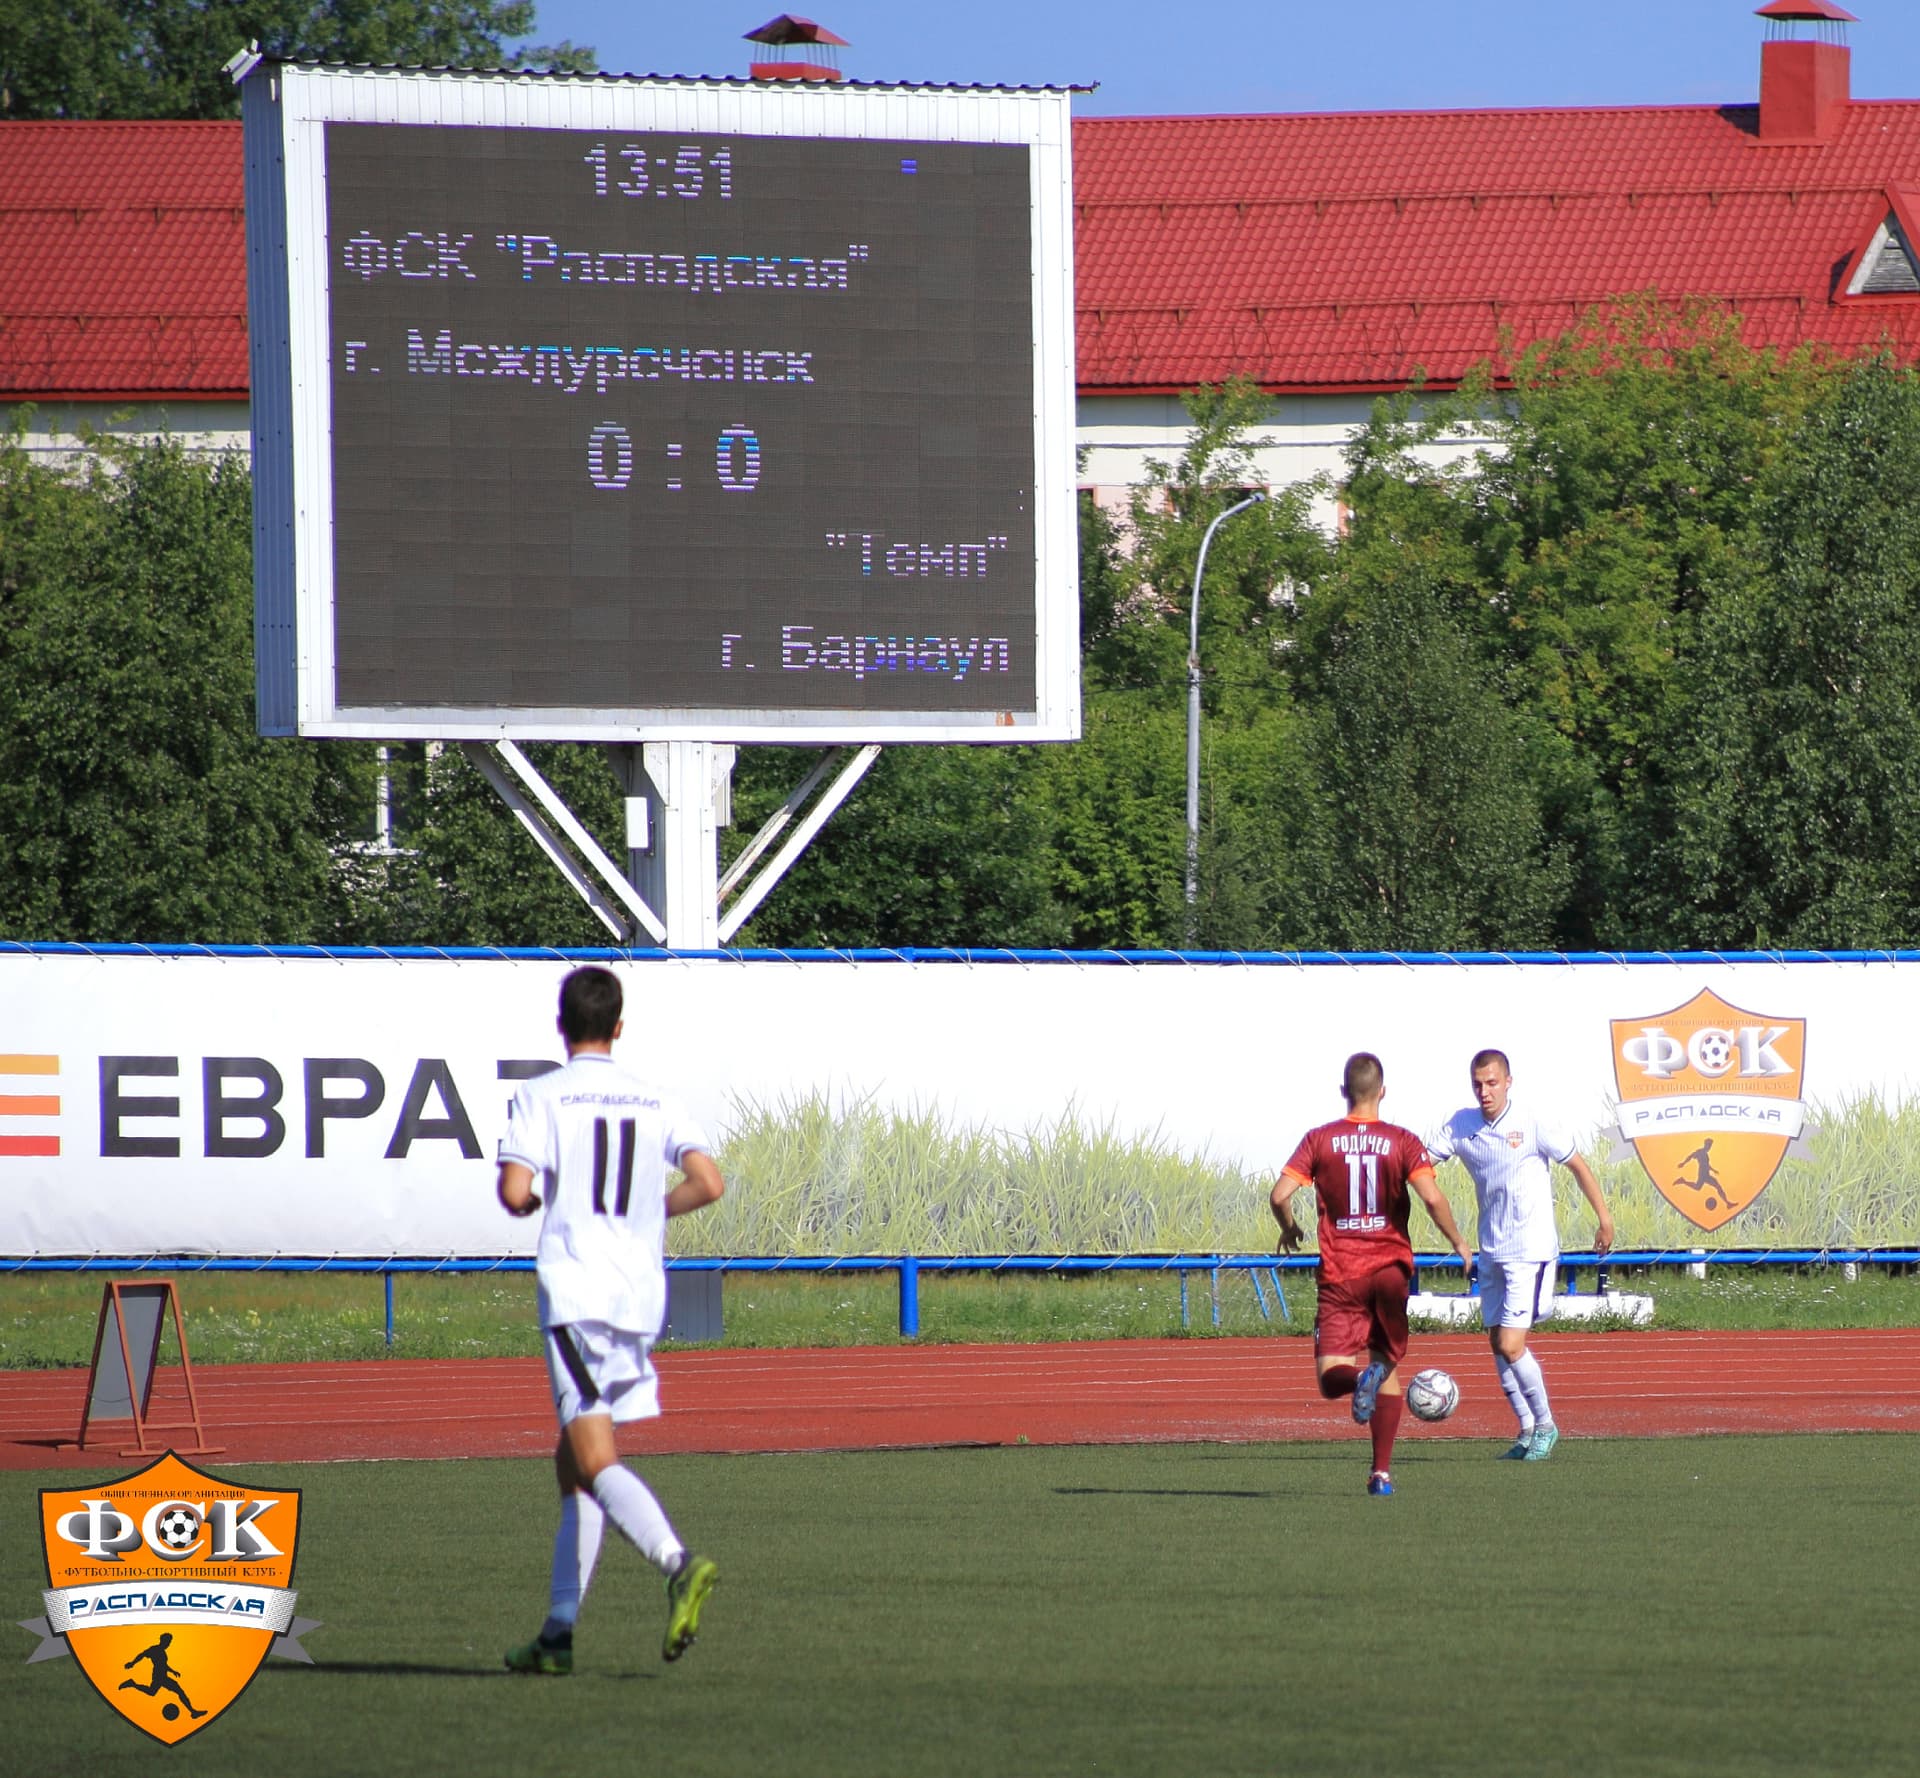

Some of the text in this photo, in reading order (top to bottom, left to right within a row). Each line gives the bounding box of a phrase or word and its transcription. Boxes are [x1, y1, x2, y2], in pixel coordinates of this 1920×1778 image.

[583, 143, 731, 200] 13:51
[344, 231, 477, 281] ФСК
[345, 341, 381, 372] г.
[588, 421, 632, 490] 0
[716, 423, 761, 491] 0
[721, 625, 1009, 680] г. Барнаул
[1622, 1027, 1796, 1079] ФСК
[592, 1116, 636, 1217] 11
[1332, 1134, 1391, 1156] РОДИЧЕВ
[1344, 1154, 1377, 1215] 11
[1336, 1216, 1386, 1230] SEUS
